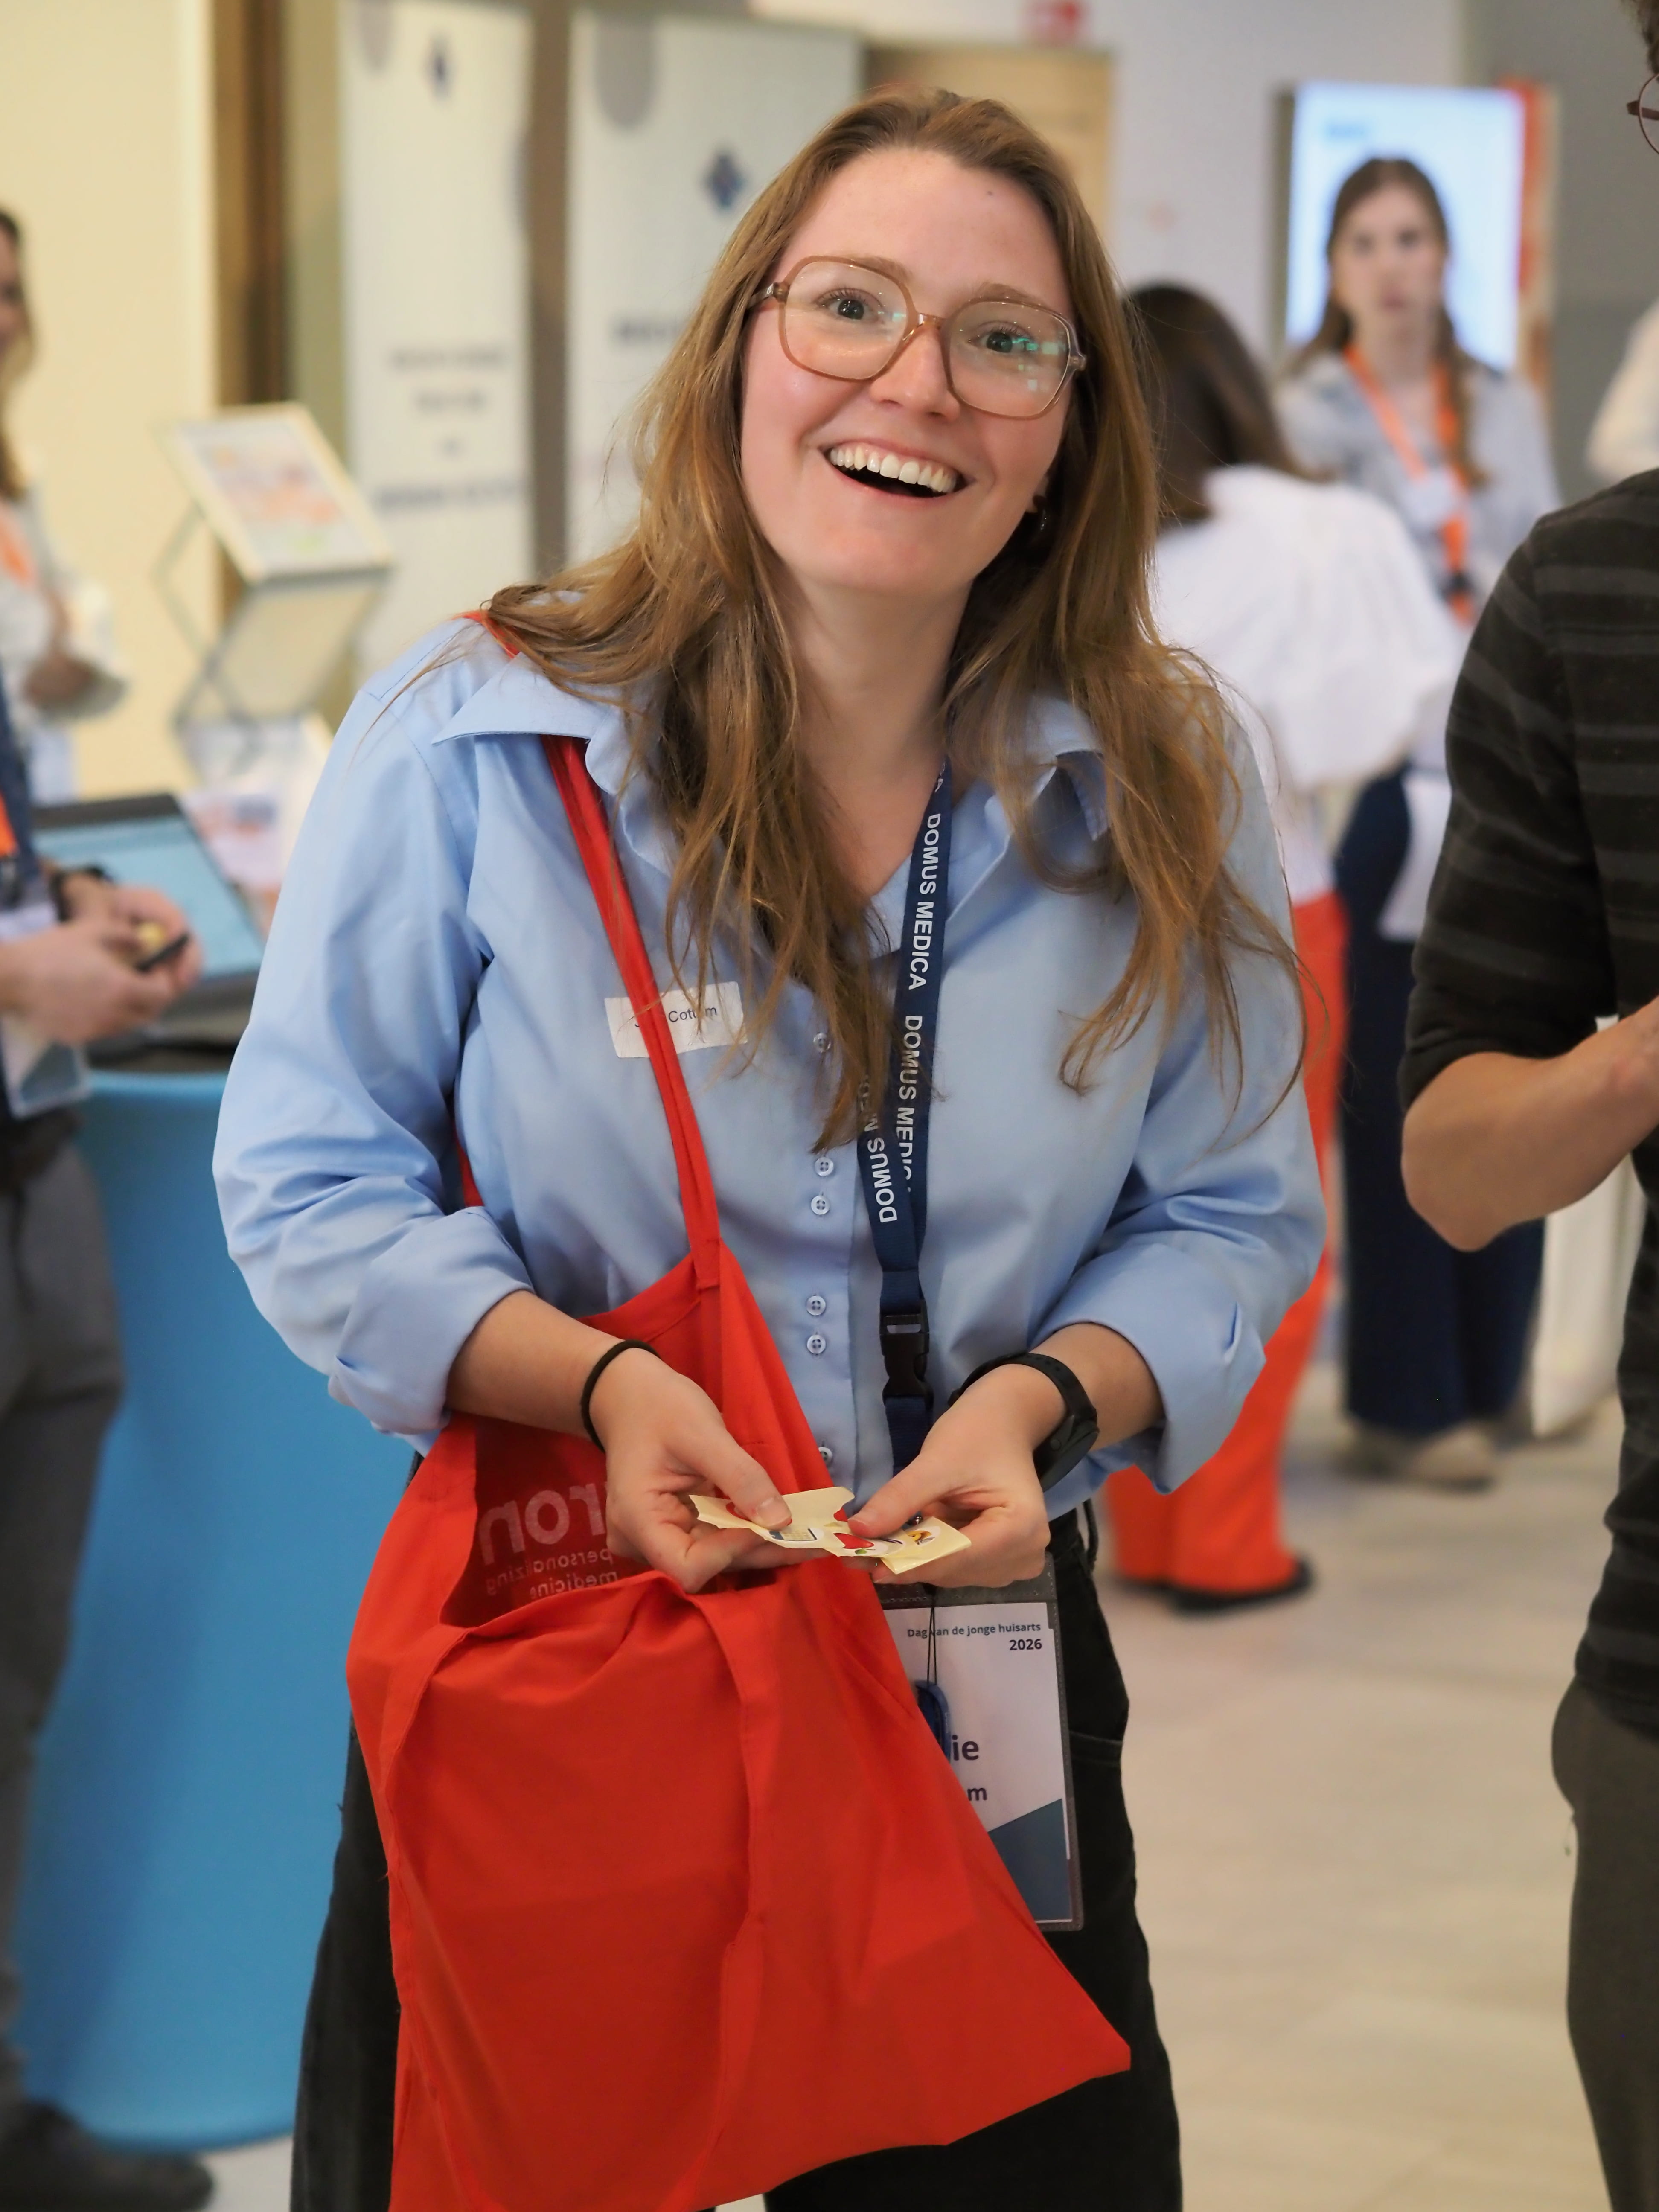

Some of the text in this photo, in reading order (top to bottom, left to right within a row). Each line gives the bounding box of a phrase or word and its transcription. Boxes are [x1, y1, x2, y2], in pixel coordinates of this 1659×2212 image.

[908, 813, 941, 990] DOMUS MEDICA
[668, 1007, 717, 1022] Cottm
[898, 1016, 923, 1100] DOMUS
[867, 1137, 897, 1223] DOMUS
[908, 1629, 927, 1638] Dag
[952, 1626, 964, 1635] de
[966, 1625, 995, 1636] jonge
[998, 1623, 1041, 1632] huisarts
[1009, 1638, 1042, 1650] 2026
